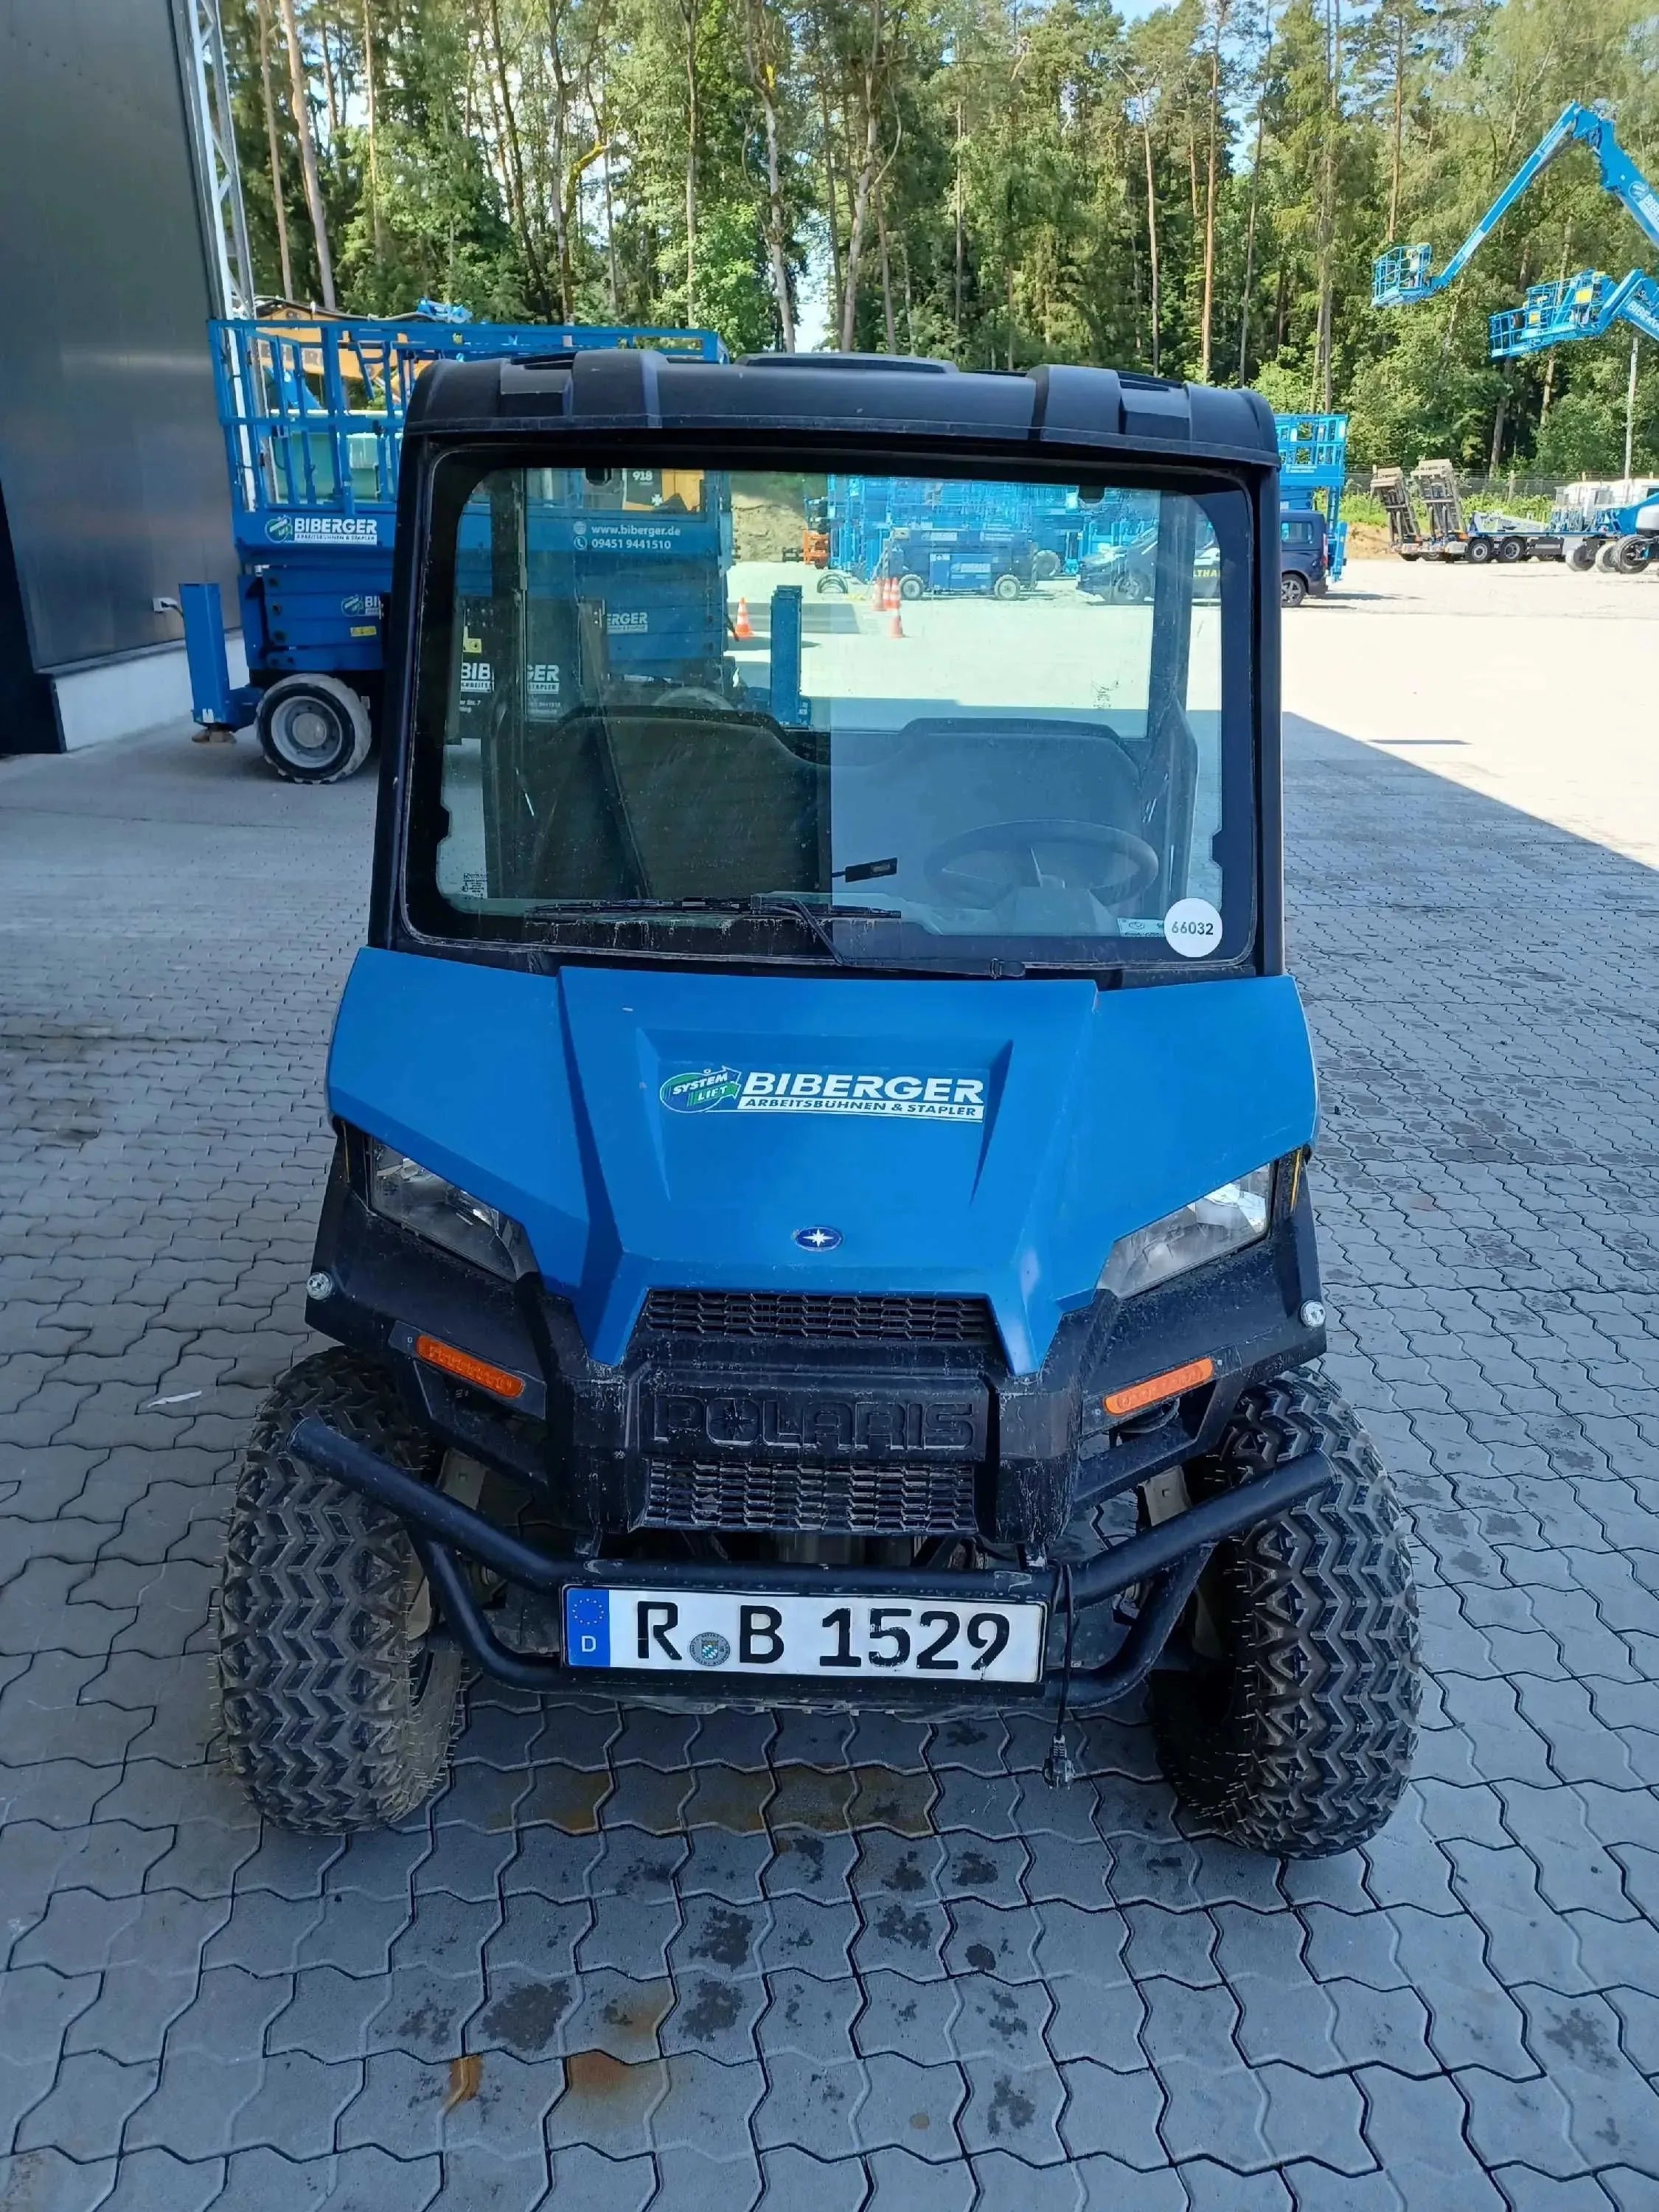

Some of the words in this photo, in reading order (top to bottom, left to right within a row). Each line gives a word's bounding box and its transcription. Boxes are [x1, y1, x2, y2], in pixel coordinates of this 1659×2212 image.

[633, 470, 653, 481] 918
[295, 518, 378, 535] BIBERGER
[591, 524, 681, 538] www.biberger.de
[591, 538, 624, 549] 09451
[626, 539, 672, 549] 9441510
[1171, 921, 1214, 936] 66032
[672, 1071, 728, 1095] SYSTEM
[742, 1071, 984, 1104] BIBERGER
[697, 1085, 728, 1102] LIFT
[745, 1099, 886, 1111] ARBEITSBÜHNEN
[891, 1103, 903, 1112] &
[907, 1104, 976, 1116] STAPLER
[653, 1394, 975, 1451] POLARIS
[580, 1635, 597, 1653] D
[636, 1600, 683, 1661] R
[739, 1604, 785, 1665] B
[818, 1607, 1012, 1671] 1529
